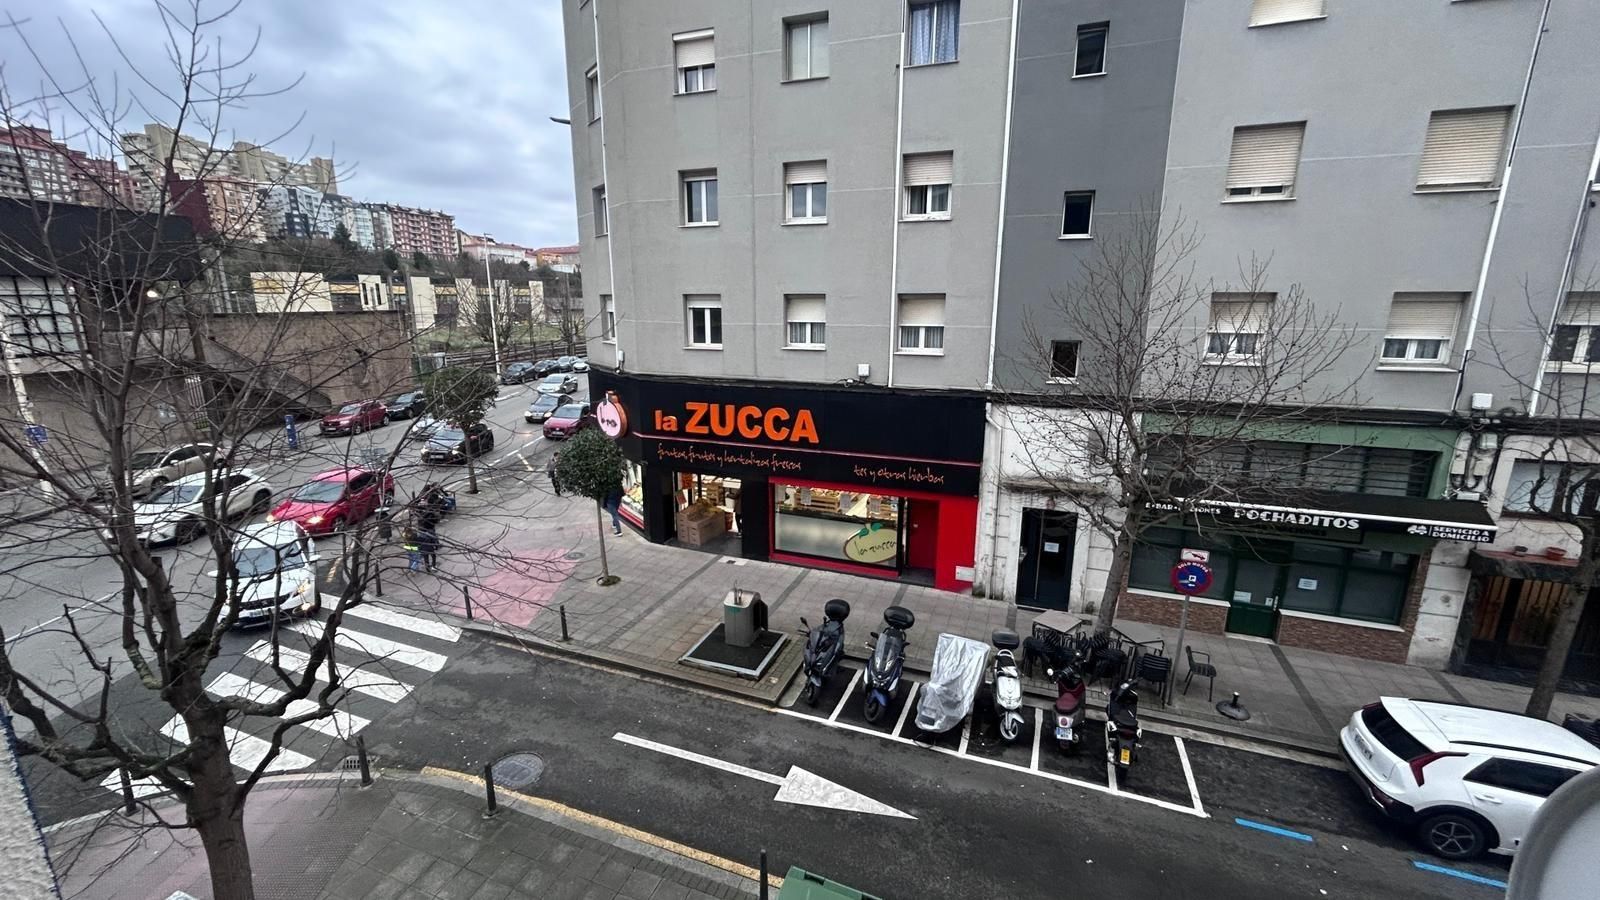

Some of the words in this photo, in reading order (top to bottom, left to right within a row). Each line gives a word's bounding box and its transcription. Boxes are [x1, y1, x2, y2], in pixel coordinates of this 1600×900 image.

[655, 410, 677, 431] la
[685, 402, 819, 443] ZUCCA
[869, 469, 876, 483] y
[877, 467, 906, 481] otras
[908, 467, 944, 484] hierbas
[1432, 532, 1490, 542] DOMICILIO
[1433, 526, 1480, 535] SERVICIO
